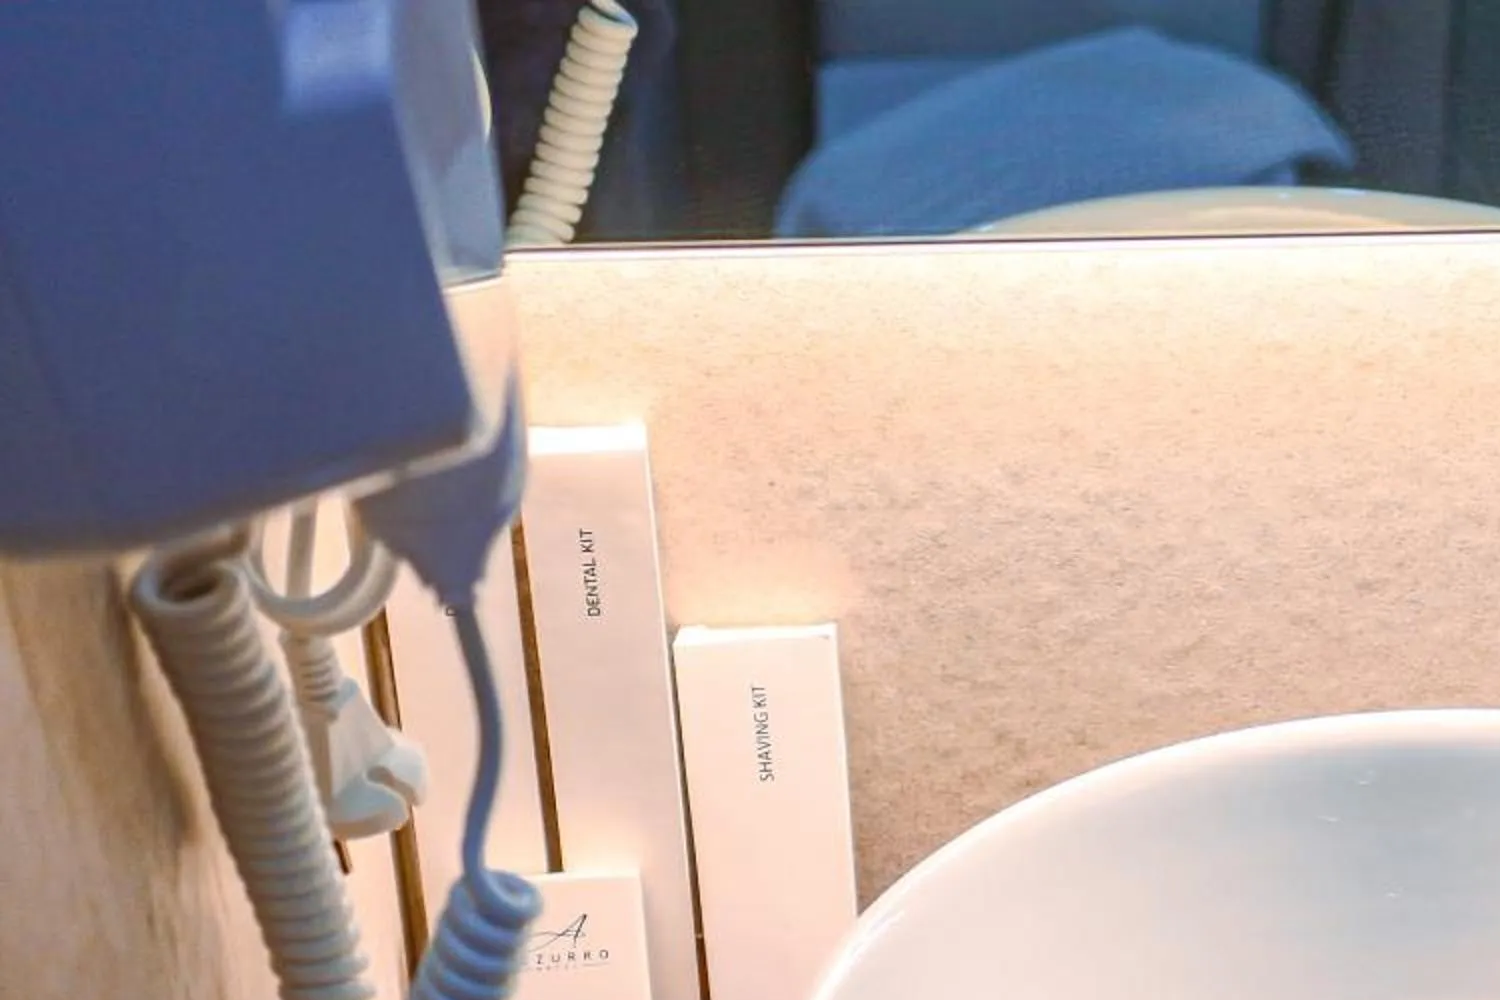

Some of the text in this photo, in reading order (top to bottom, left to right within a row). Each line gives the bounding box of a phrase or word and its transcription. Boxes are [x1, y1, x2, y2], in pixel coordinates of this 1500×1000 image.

[579, 527, 601, 617] DENTAL KIT
[751, 684, 775, 782] SHAVING KIT
